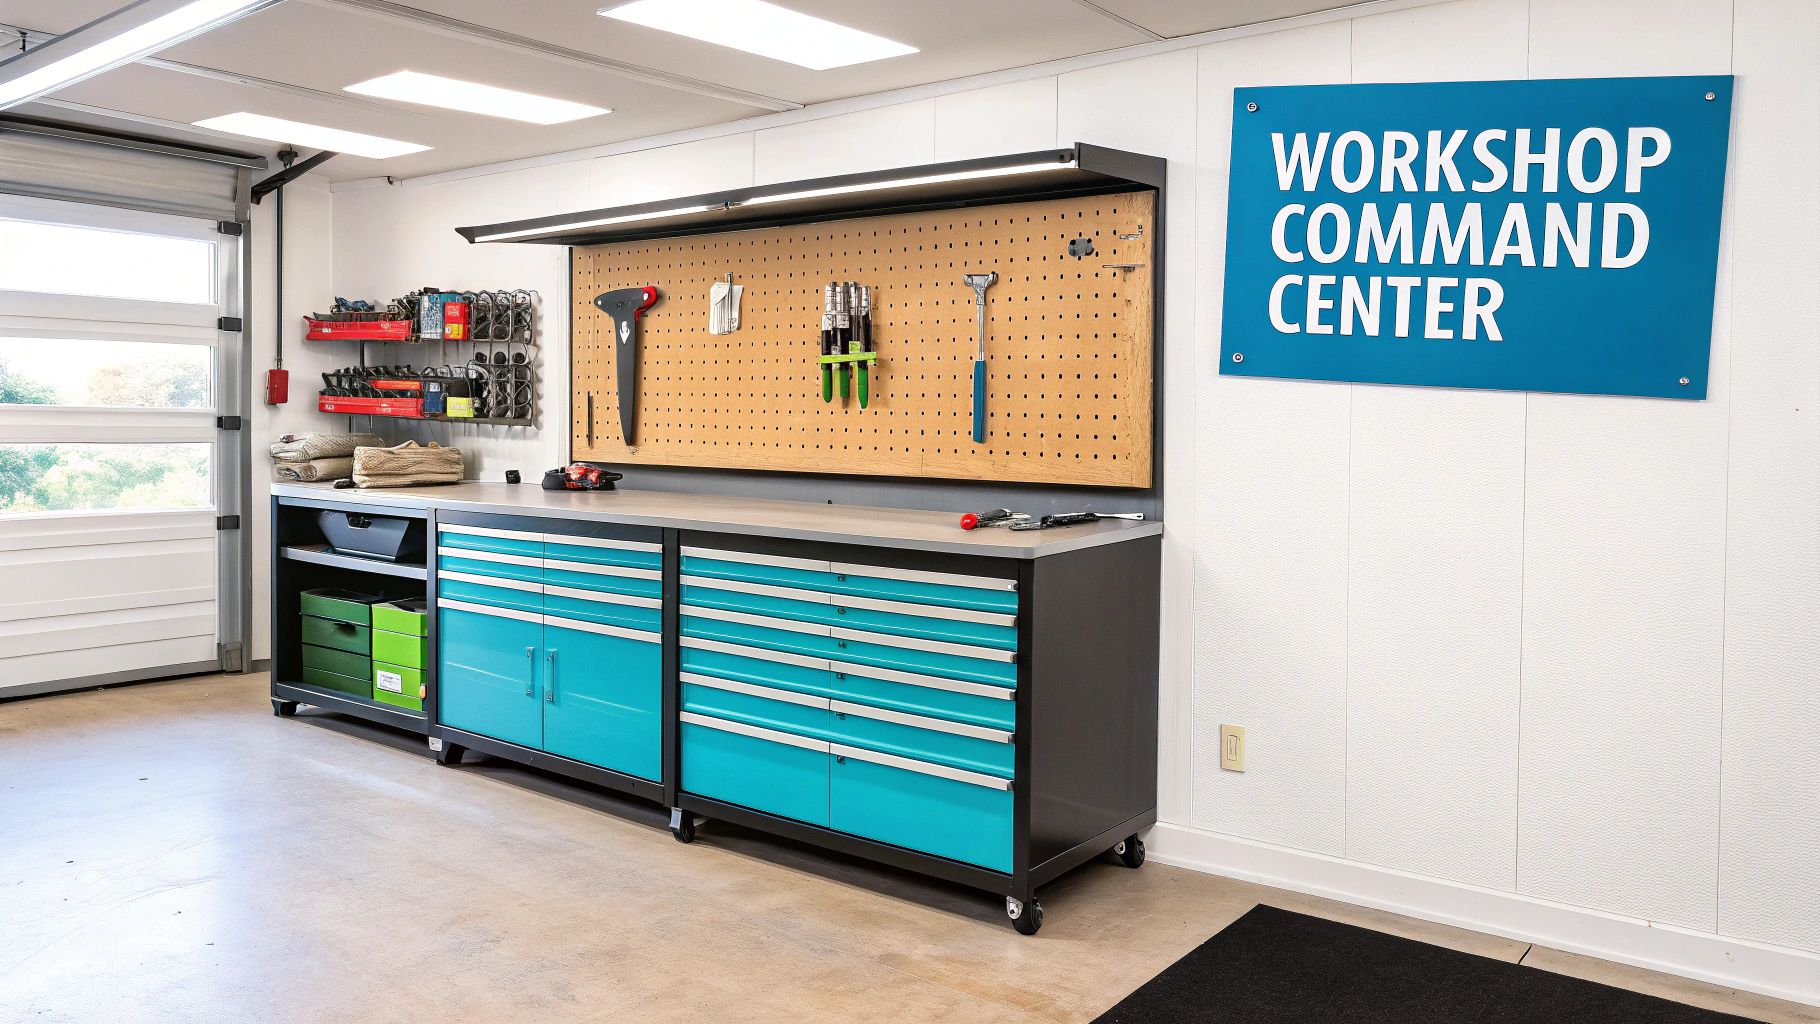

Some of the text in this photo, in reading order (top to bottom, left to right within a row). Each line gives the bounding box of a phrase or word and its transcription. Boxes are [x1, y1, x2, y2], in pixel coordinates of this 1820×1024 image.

[1271, 127, 1671, 194] WORKSHOP
[1271, 202, 1650, 269] COMMAND
[1268, 274, 1504, 342] CENTER
